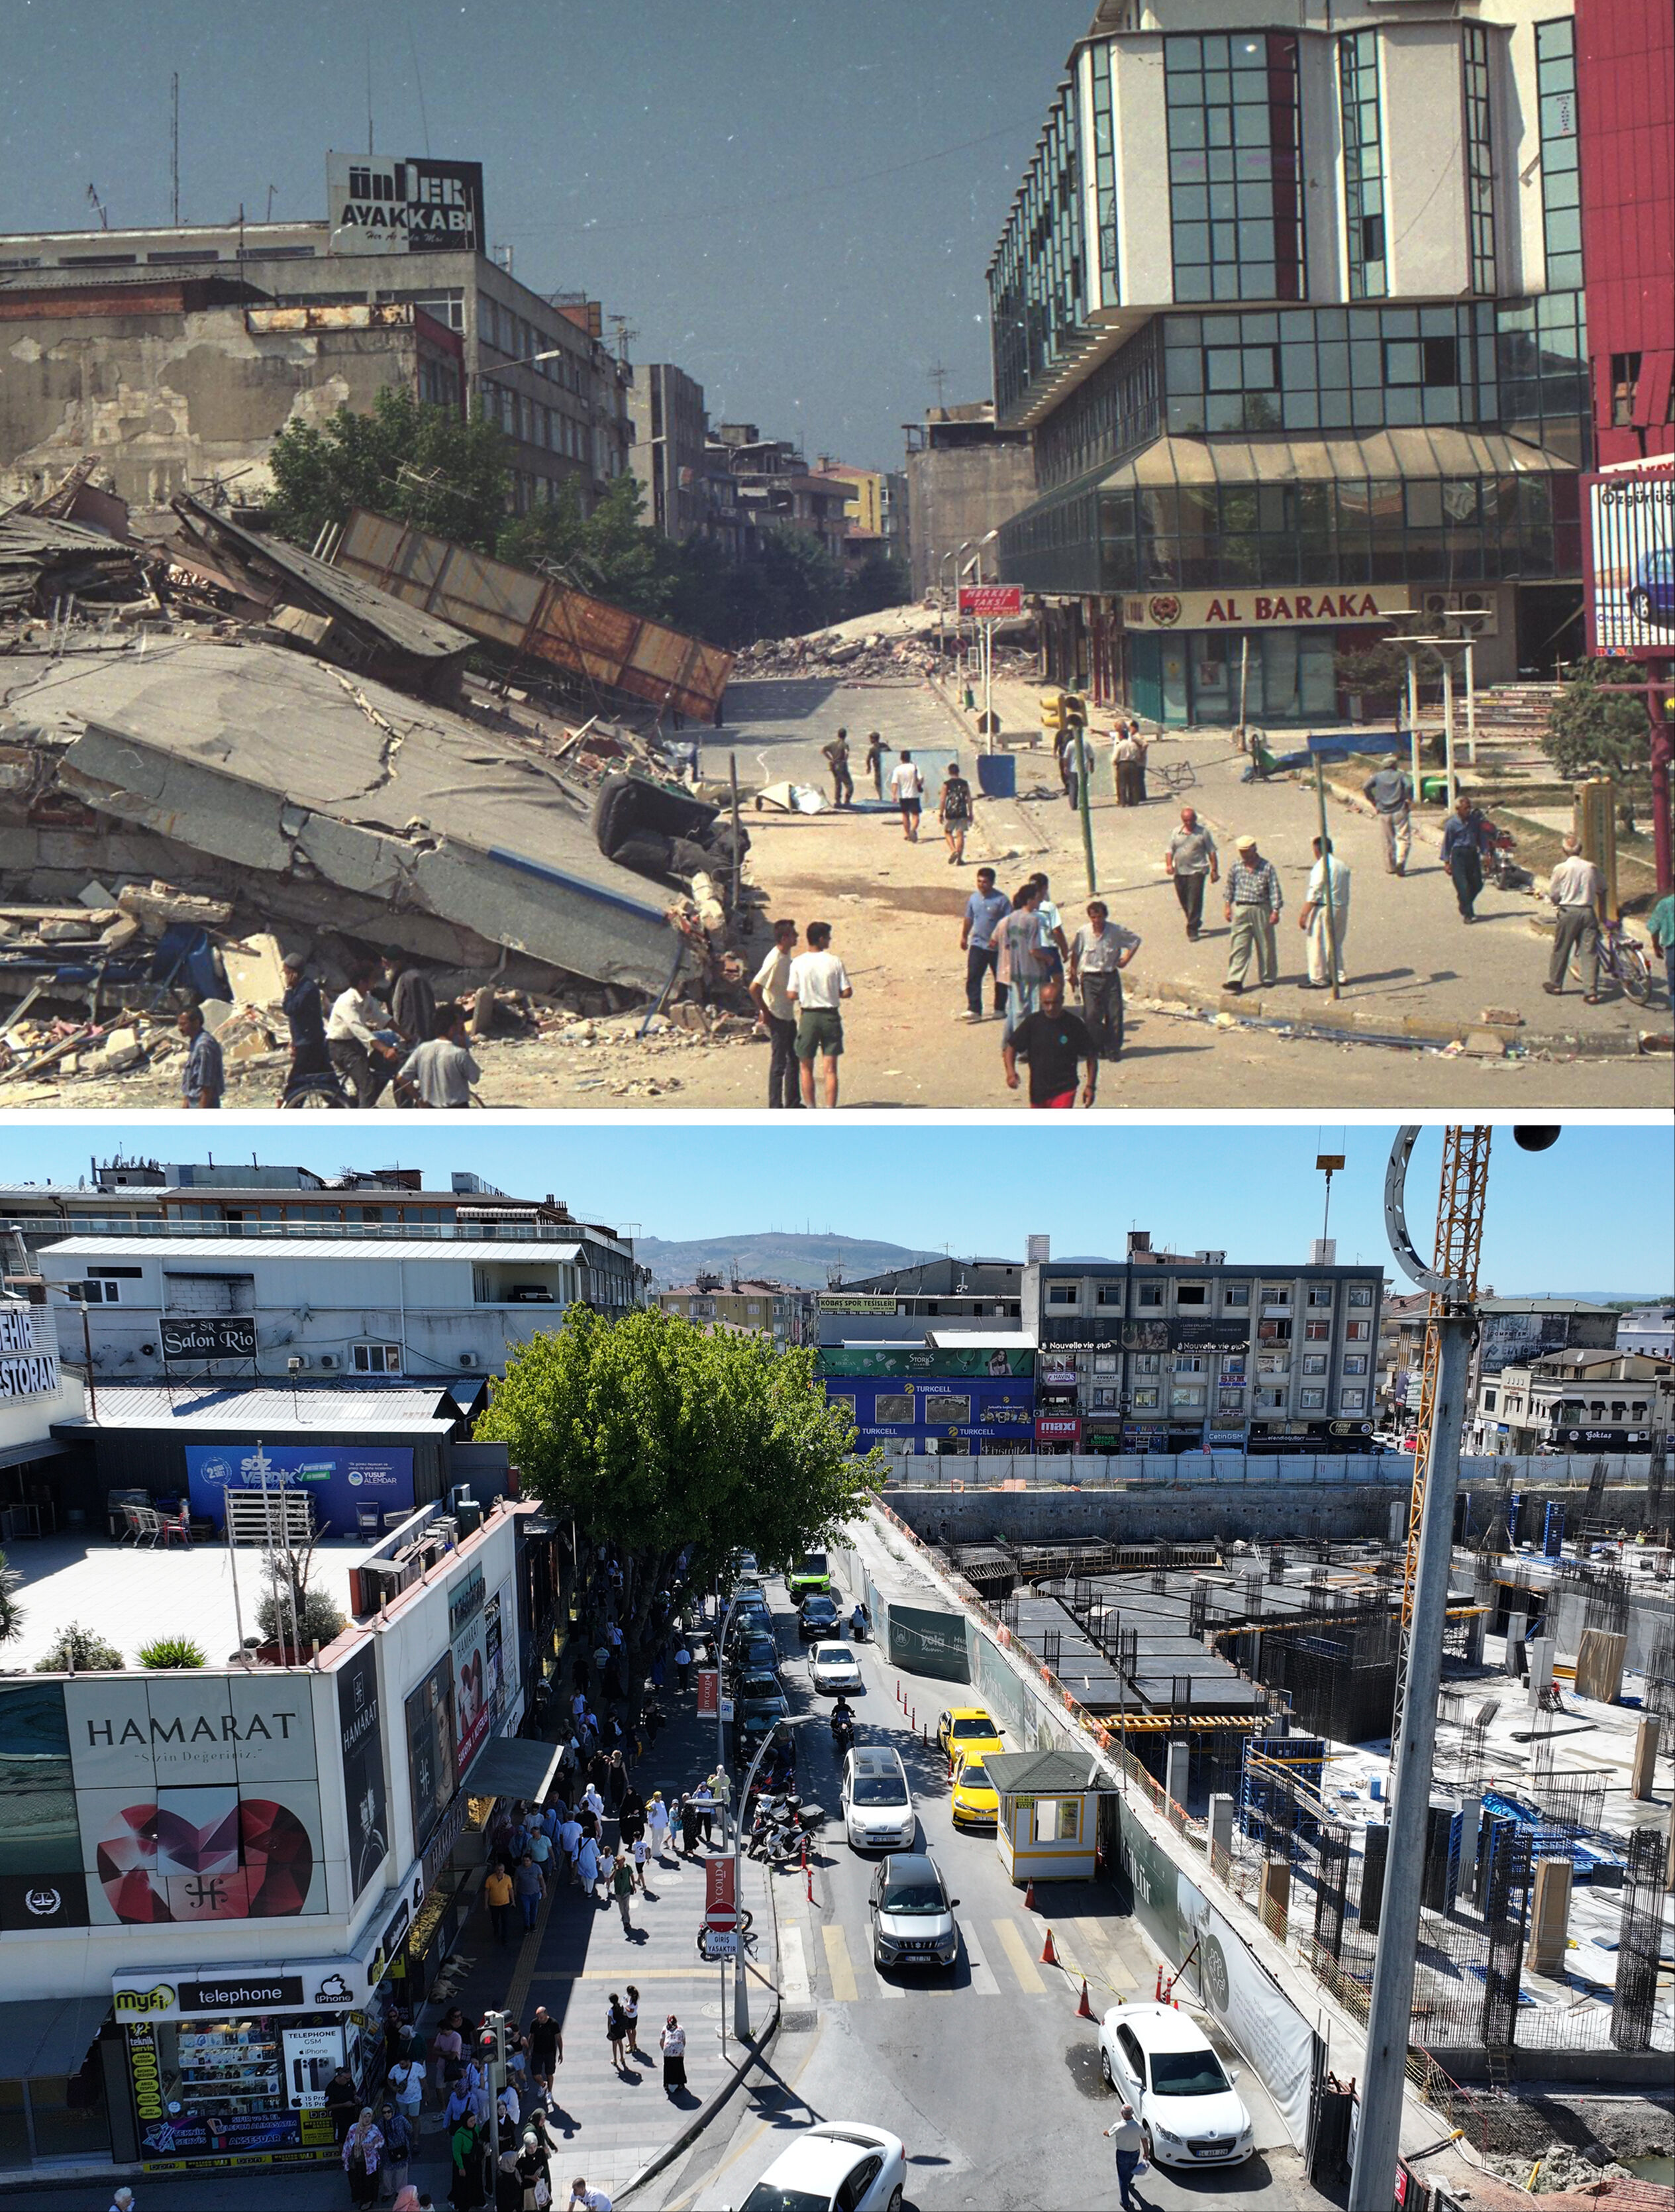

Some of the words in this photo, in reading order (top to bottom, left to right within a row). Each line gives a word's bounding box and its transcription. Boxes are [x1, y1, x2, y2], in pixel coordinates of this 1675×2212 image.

[340, 204, 473, 231] AYAKKABI
[966, 588, 1013, 598] MERKEZ
[1205, 598, 1243, 622] AL
[1255, 594, 1380, 620] BARAKA
[165, 1332, 215, 1353] Salon
[219, 1331, 254, 1353] Rio
[1096, 1342, 1111, 1350] plus
[909, 1353, 935, 1363] STORKS
[0, 1356, 58, 1398] STORAN
[1041, 1420, 1076, 1431] maxi
[240, 1455, 272, 1471] SÖZ
[240, 1469, 297, 1484] VERDİK
[921, 1635, 944, 1648] yola
[87, 1712, 297, 1746] HAMARAT
[343, 1699, 377, 1753] HAMARAT
[715, 1869, 724, 1895] GOLD
[714, 1935, 730, 1944] GİRİŞ
[199, 1988, 283, 2005] telephone
[317, 1994, 352, 2003] iPhone
[288, 2030, 336, 2039] TELEPHONE
[130, 2036, 154, 2046] teknik
[174, 2127, 206, 2137] TEKNİK
[216, 2123, 250, 2133] TELEFON
[174, 2136, 207, 2146] SERVİS
[228, 2135, 281, 2145] AKSESUAR
